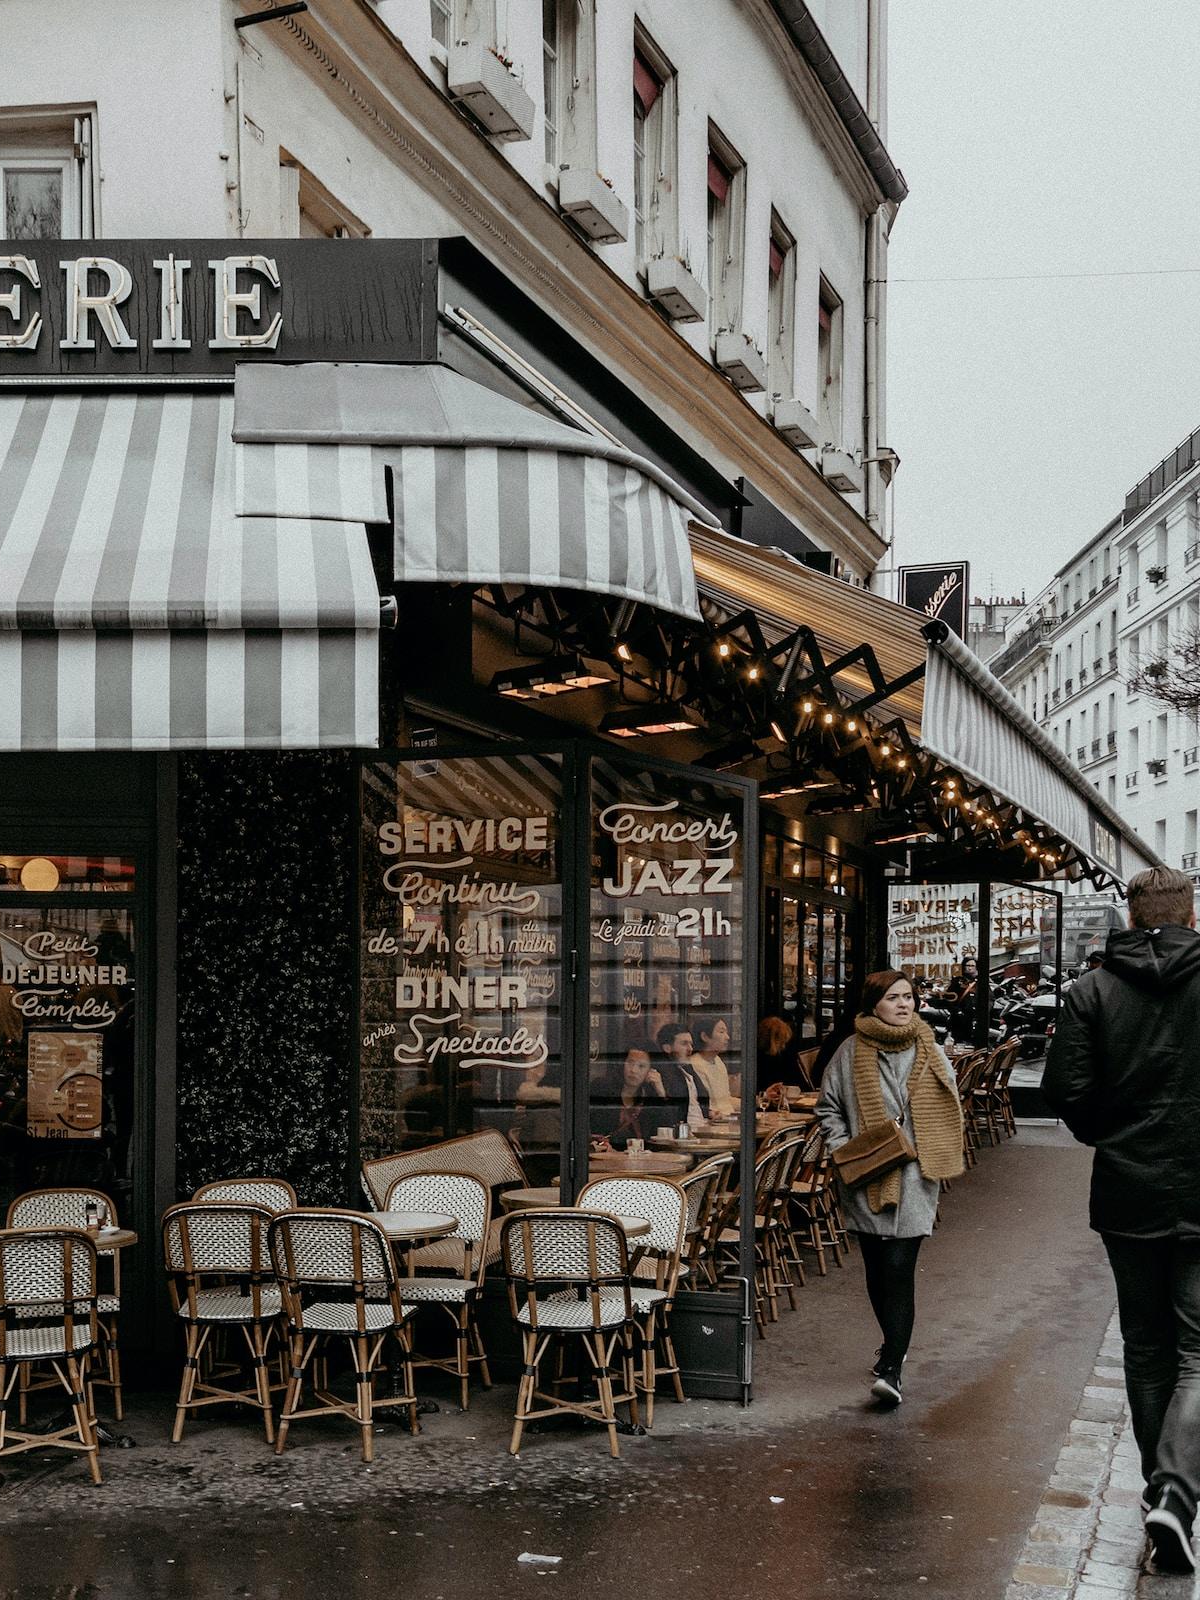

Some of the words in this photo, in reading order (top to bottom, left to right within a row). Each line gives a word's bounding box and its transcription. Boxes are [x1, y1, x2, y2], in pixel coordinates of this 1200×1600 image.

[378, 816, 548, 855] SERVICE
[599, 800, 737, 850] Concert
[383, 856, 539, 915] Continu
[603, 858, 734, 897] JAZZ
[367, 928, 399, 955] de
[409, 921, 450, 954] 7h
[521, 920, 540, 933] du
[593, 918, 613, 942] Le
[614, 920, 655, 945] jeudi
[675, 907, 732, 937] 21h
[24, 931, 99, 960] Petit
[508, 938, 556, 955] matin
[2, 964, 128, 985] DEJEUNER
[12, 988, 116, 1028] Complet
[396, 976, 528, 1009] DINER
[363, 1023, 397, 1047] après
[394, 1013, 548, 1068] Spectacles
